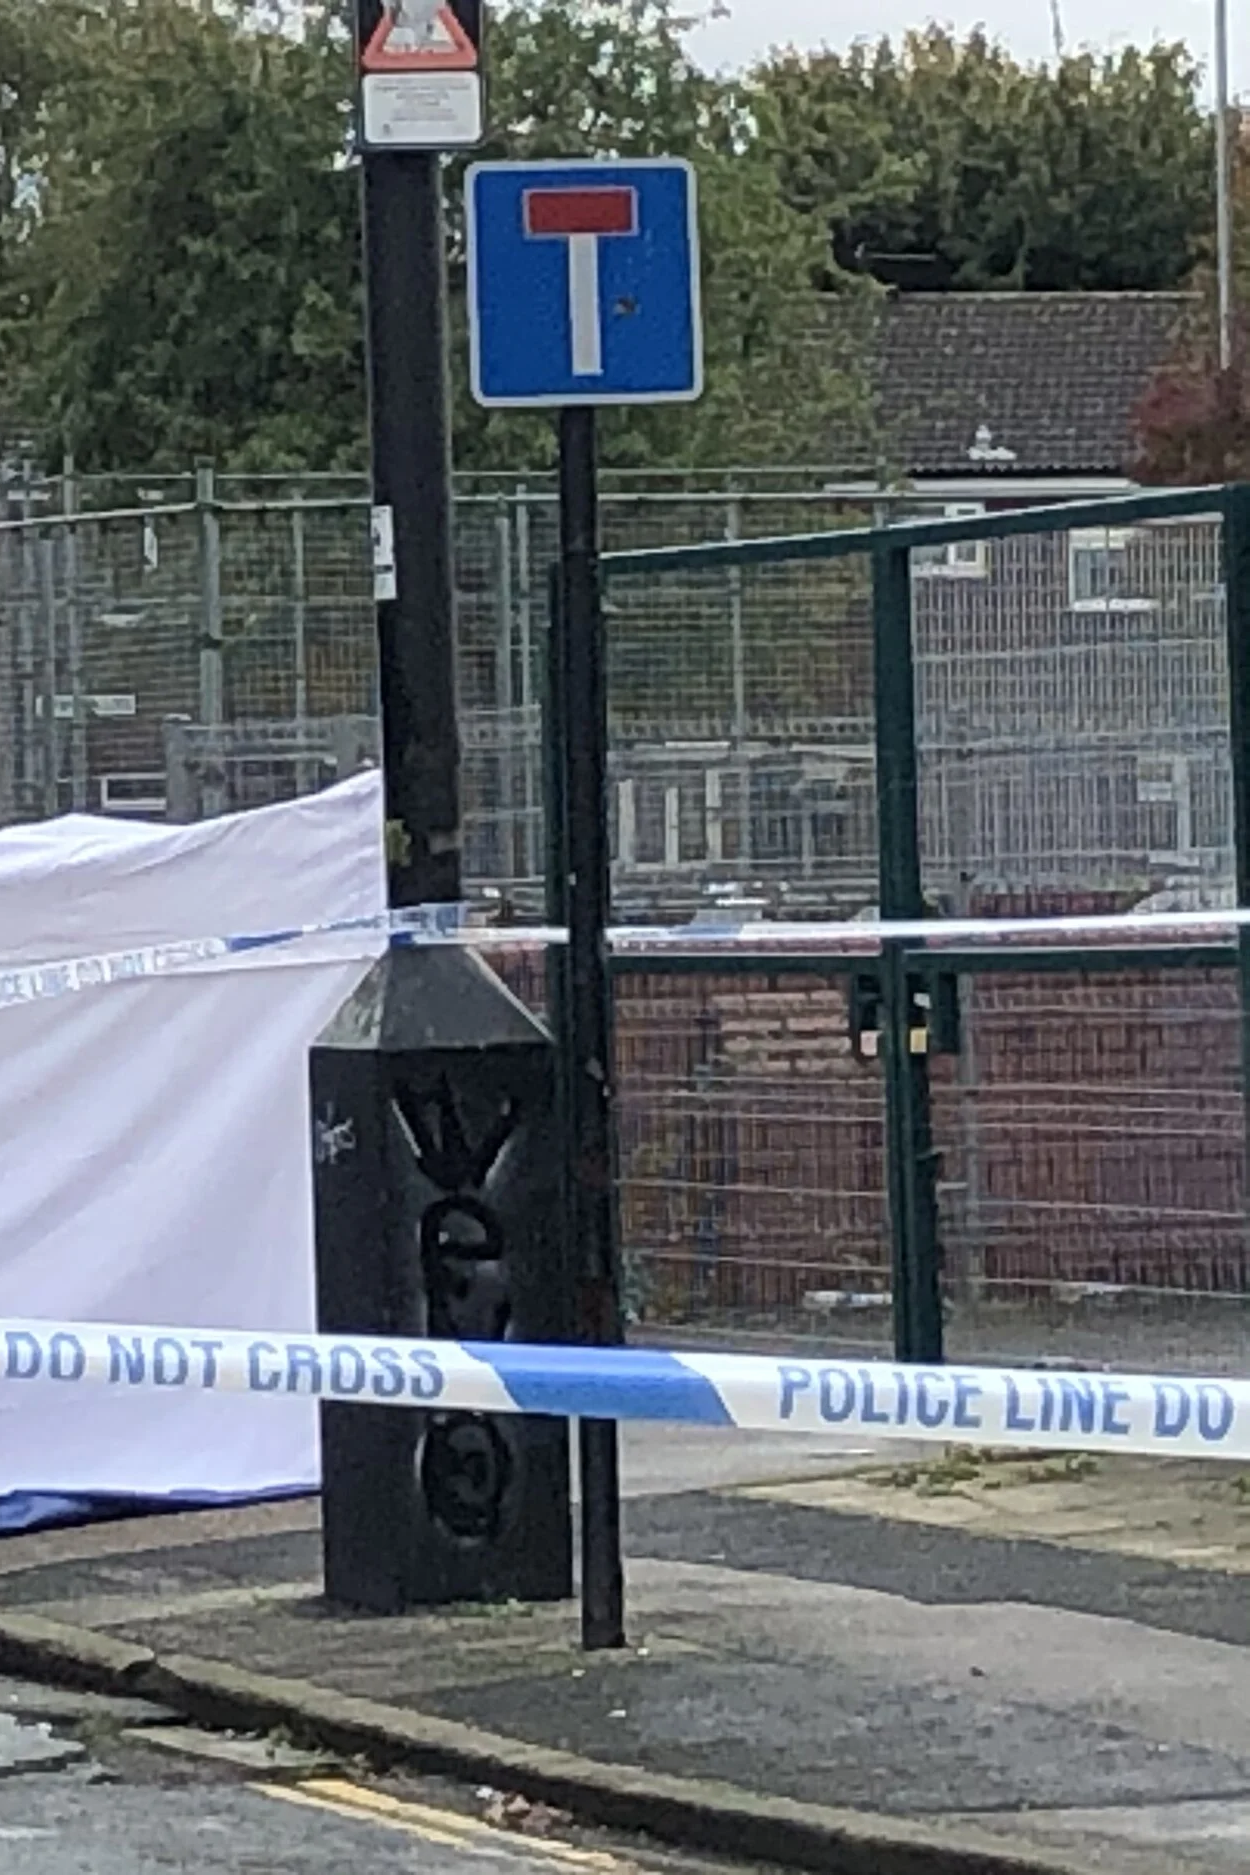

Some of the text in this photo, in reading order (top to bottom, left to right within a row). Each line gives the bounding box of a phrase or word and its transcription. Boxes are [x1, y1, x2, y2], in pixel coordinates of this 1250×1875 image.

[4, 1331, 86, 1383] DO
[107, 1334, 224, 1389] NOT
[248, 1340, 446, 1399] CROSS
[776, 1364, 1235, 1442] POLICE LINE DO
